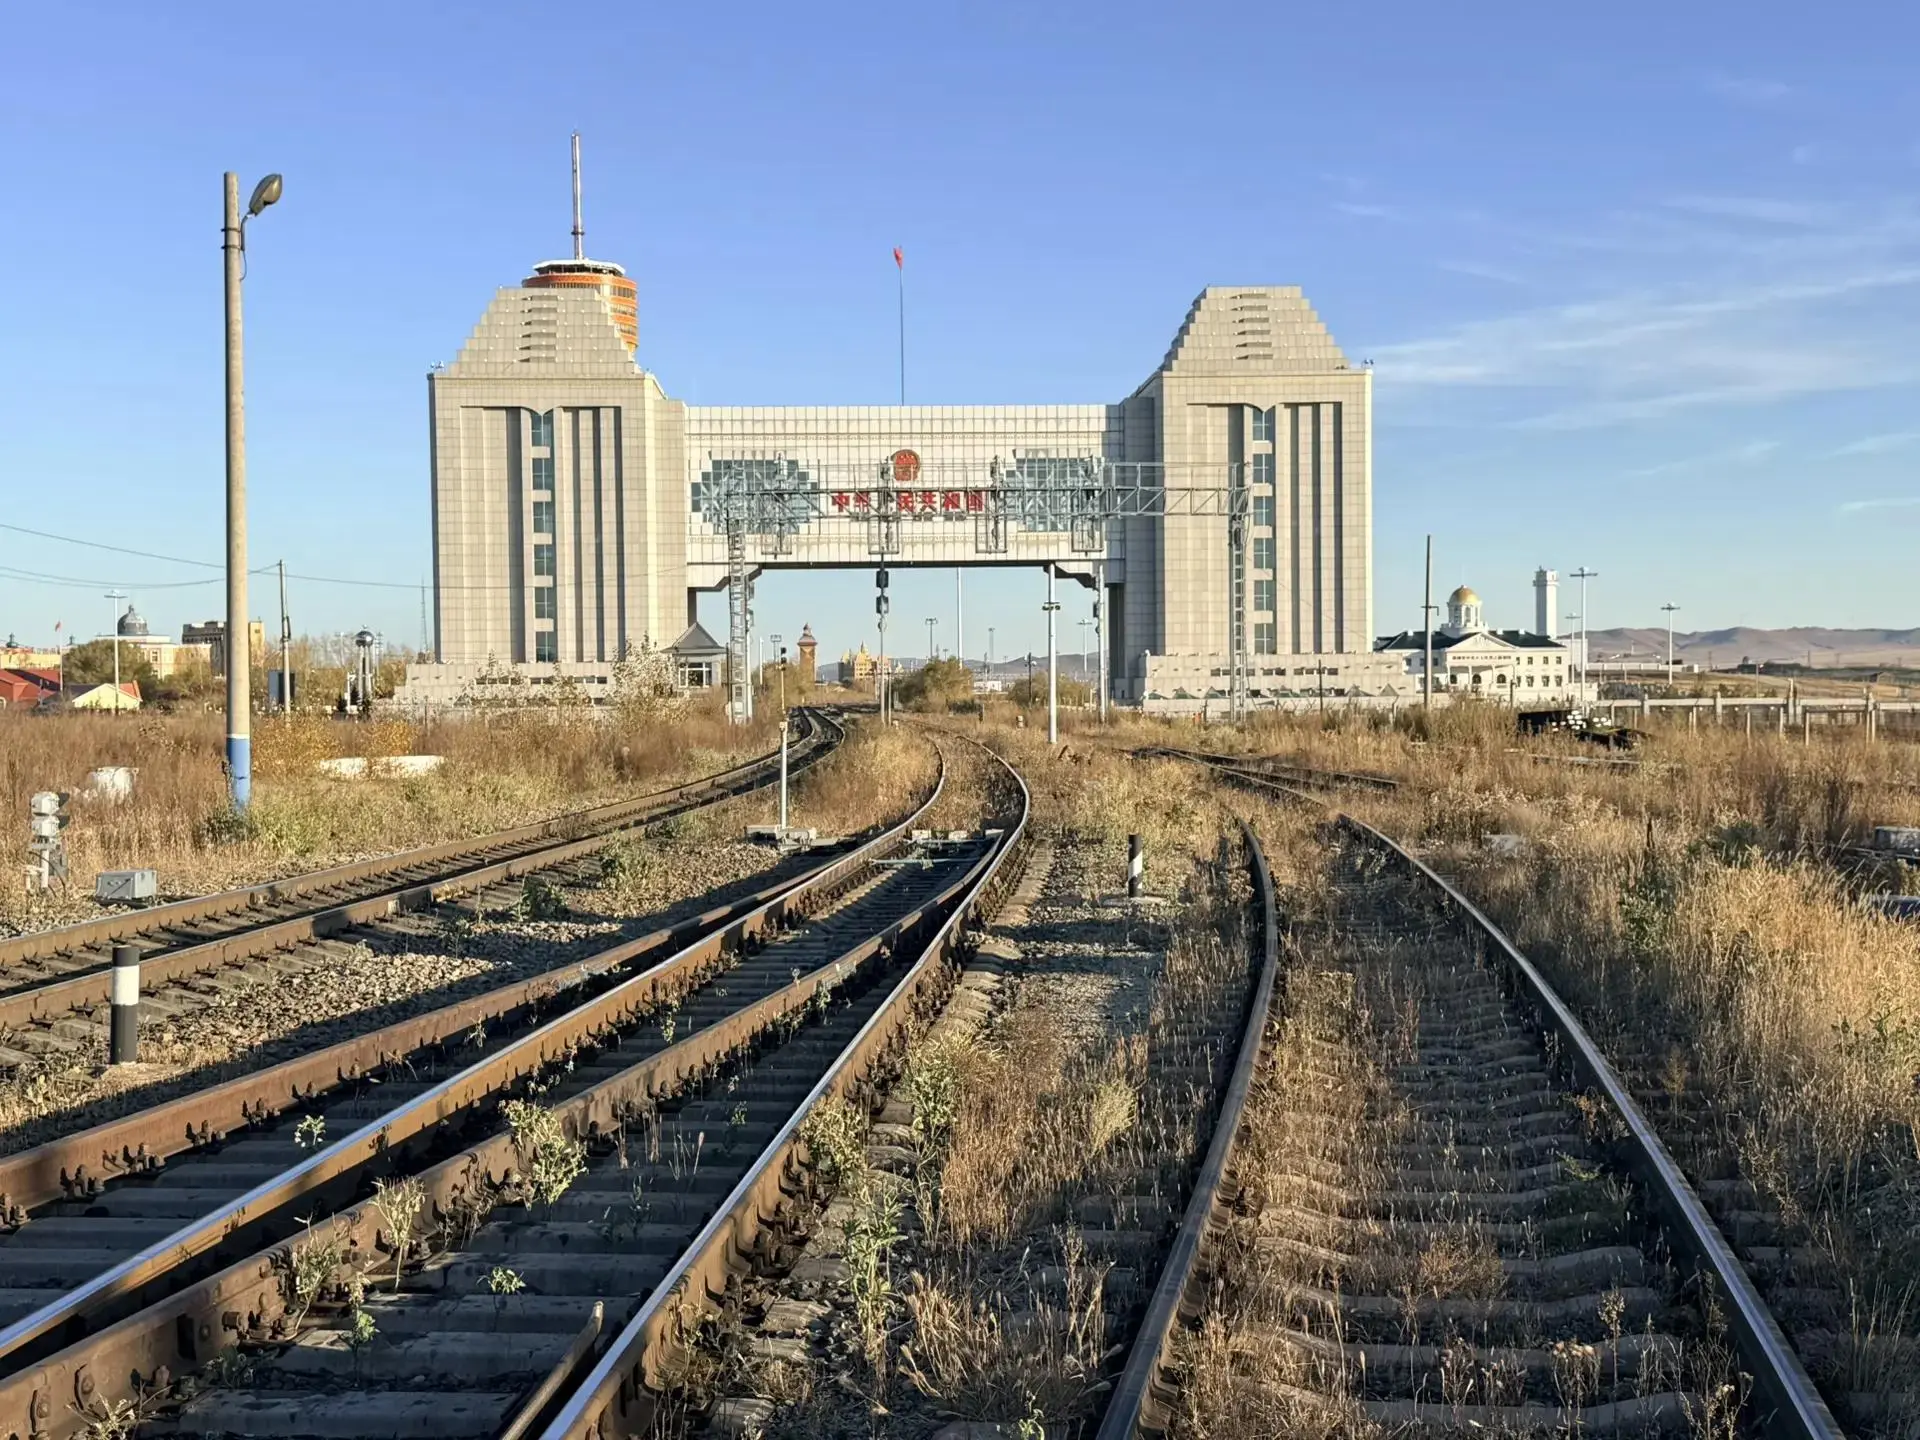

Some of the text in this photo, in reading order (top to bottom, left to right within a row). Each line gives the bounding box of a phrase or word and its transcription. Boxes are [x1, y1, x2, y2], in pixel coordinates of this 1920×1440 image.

[831, 490, 983, 512] 中华民共和国
